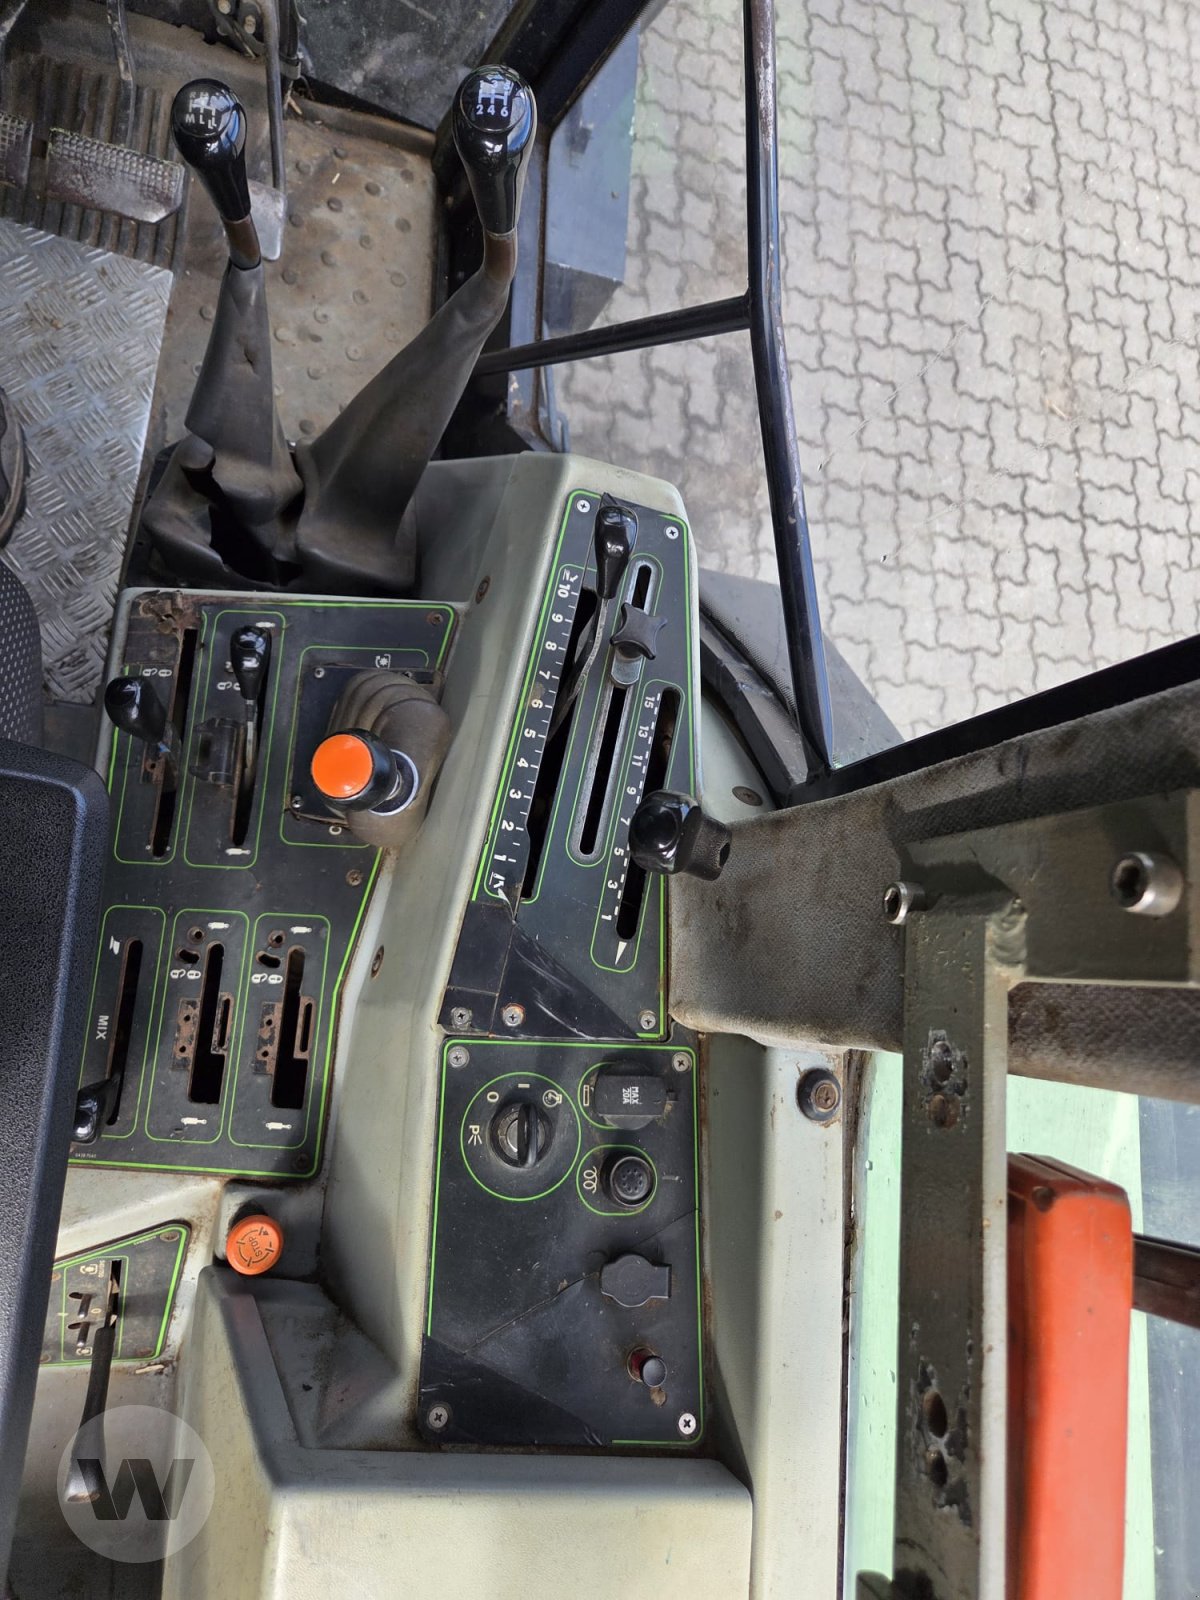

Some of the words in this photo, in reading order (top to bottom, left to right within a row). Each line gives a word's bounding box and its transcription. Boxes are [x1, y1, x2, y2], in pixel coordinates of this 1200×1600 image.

[476, 104, 484, 115] 2
[487, 104, 496, 116] 4
[500, 106, 509, 117] 6
[185, 113, 195, 124] M
[199, 114, 205, 125] L
[557, 584, 571, 598] 10
[551, 613, 563, 623] 9
[545, 641, 557, 651] 8
[538, 670, 551, 680] 7
[531, 699, 543, 709] 6
[644, 695, 655, 709] 15
[523, 727, 536, 738] 5
[638, 724, 649, 739] 13
[516, 757, 529, 768] 4
[631, 754, 643, 767] 11
[509, 788, 522, 799] 3
[626, 786, 637, 795] 9
[501, 819, 514, 831] 2
[620, 816, 631, 826] 7
[613, 847, 625, 857] 5
[493, 854, 507, 862] 1
[607, 879, 618, 890] 3
[95, 1015, 109, 1040] MIX
[622, 1087, 630, 1105] 20A
[631, 1086, 640, 1105] MAX
[248, 1236, 263, 1257] STOP
